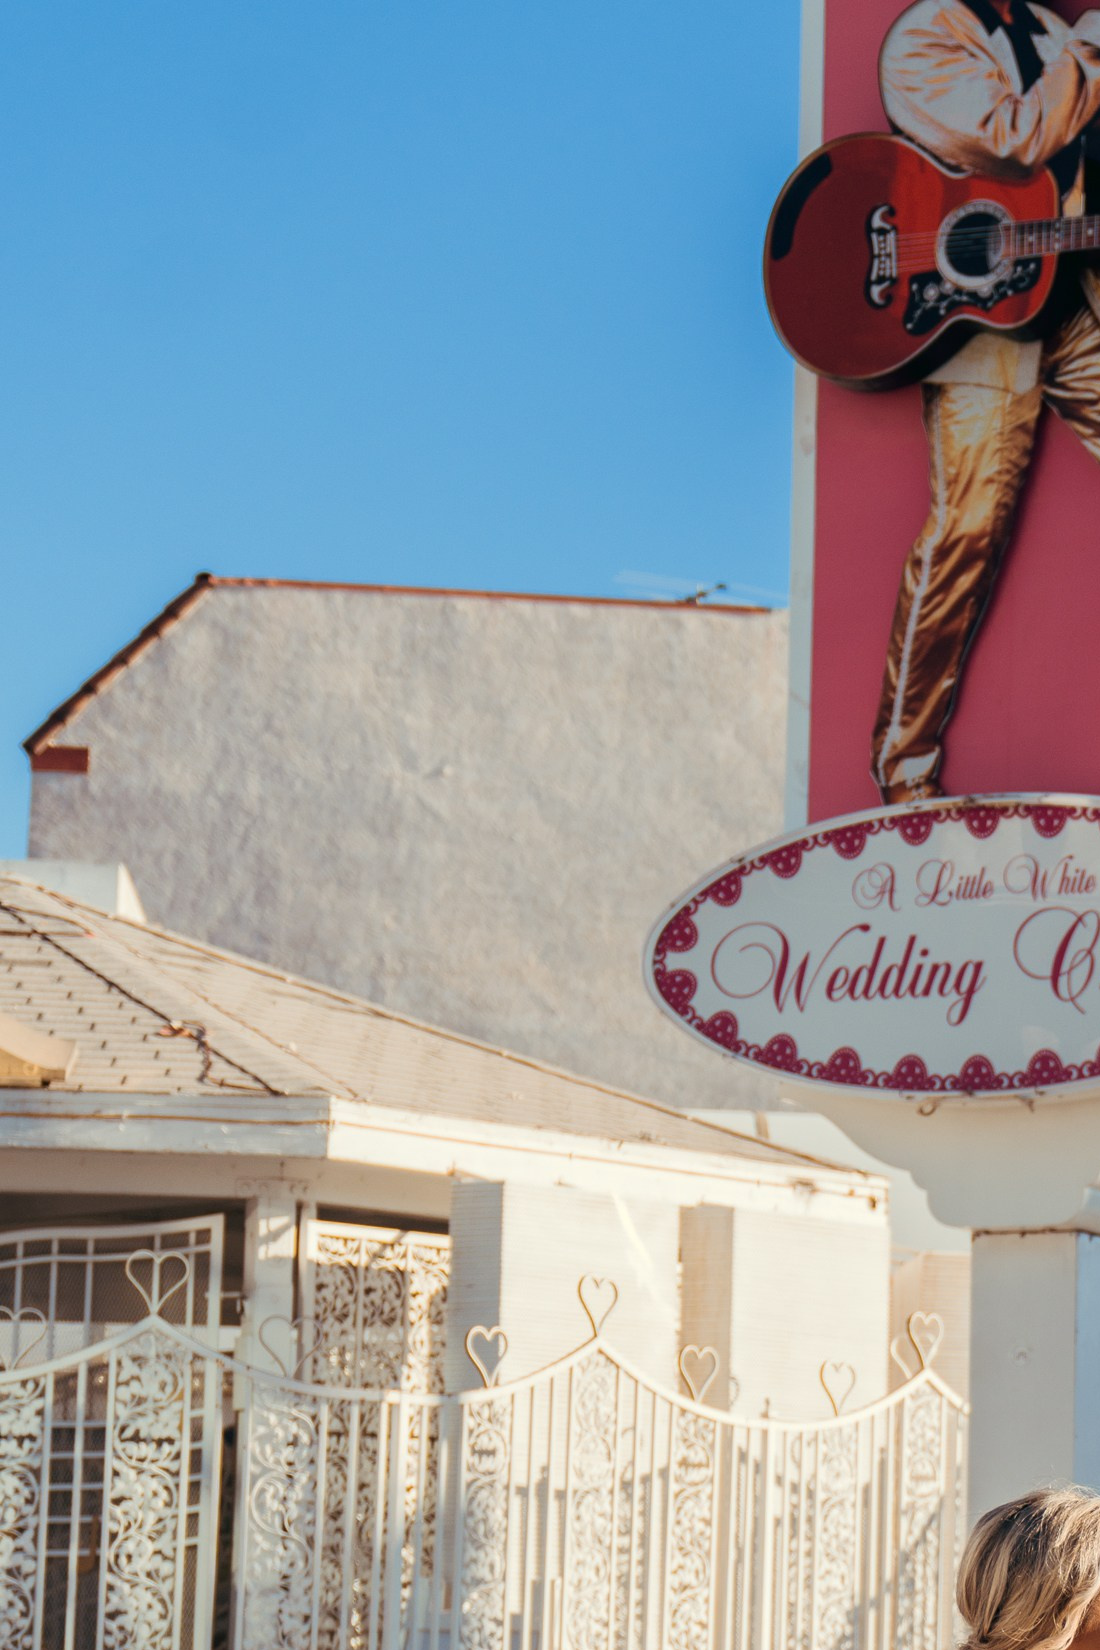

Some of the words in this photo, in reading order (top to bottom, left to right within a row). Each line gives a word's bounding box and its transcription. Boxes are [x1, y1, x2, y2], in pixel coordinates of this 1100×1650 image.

[852, 862, 901, 911] A
[915, 858, 994, 907] Little
[1003, 853, 1096, 901] White
[710, 921, 987, 1026] Wedding
